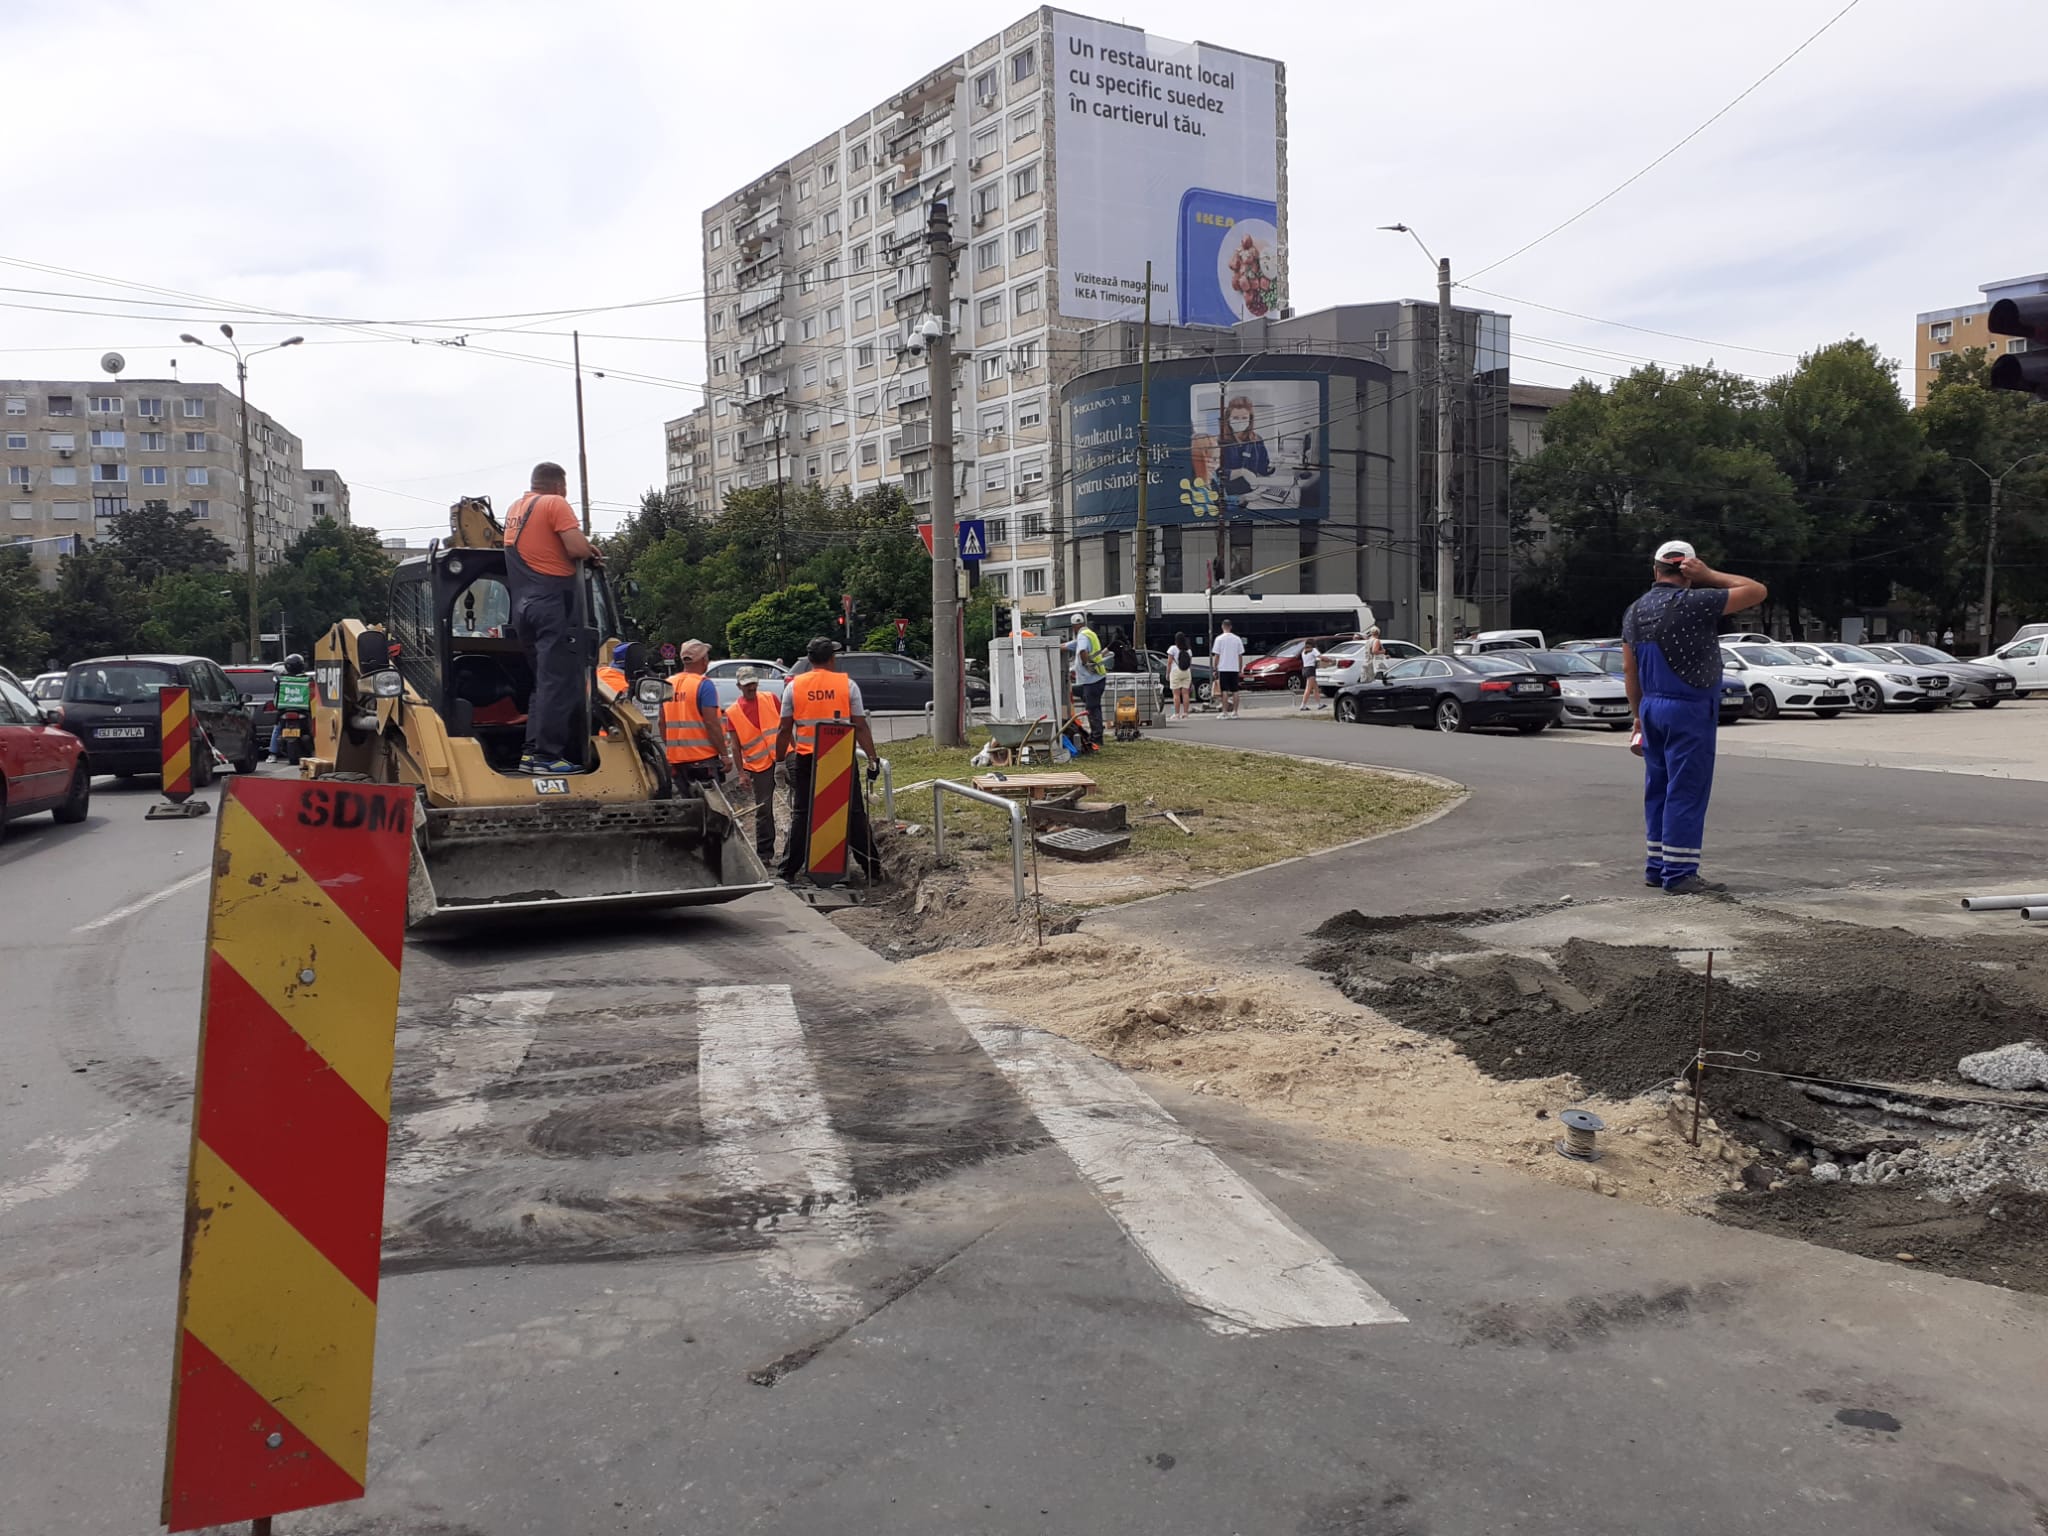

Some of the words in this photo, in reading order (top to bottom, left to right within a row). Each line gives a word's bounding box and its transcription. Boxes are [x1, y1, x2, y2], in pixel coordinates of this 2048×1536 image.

[1069, 36, 1094, 58] Un
[1100, 47, 1193, 80] restaurant
[1198, 64, 1235, 90] local
[1069, 68, 1090, 86] cu
[1096, 74, 1163, 101] specific
[1167, 89, 1225, 114] suedez
[1068, 92, 1087, 114] în
[1093, 101, 1169, 129] cartierul
[1174, 113, 1206, 137] tău.
[1195, 211, 1236, 228] IKEA
[1074, 271, 1118, 287] Vizitează
[1120, 278, 1169, 294] magainul
[1075, 287, 1098, 300] IKEA
[1099, 290, 1147, 306] Timișoara
[1125, 426, 1134, 440] a
[1118, 446, 1134, 464] de
[1104, 470, 1163, 490] sănătte.
[807, 689, 835, 701] SDM
[536, 779, 565, 793] CAT
[297, 788, 409, 834] SDM
